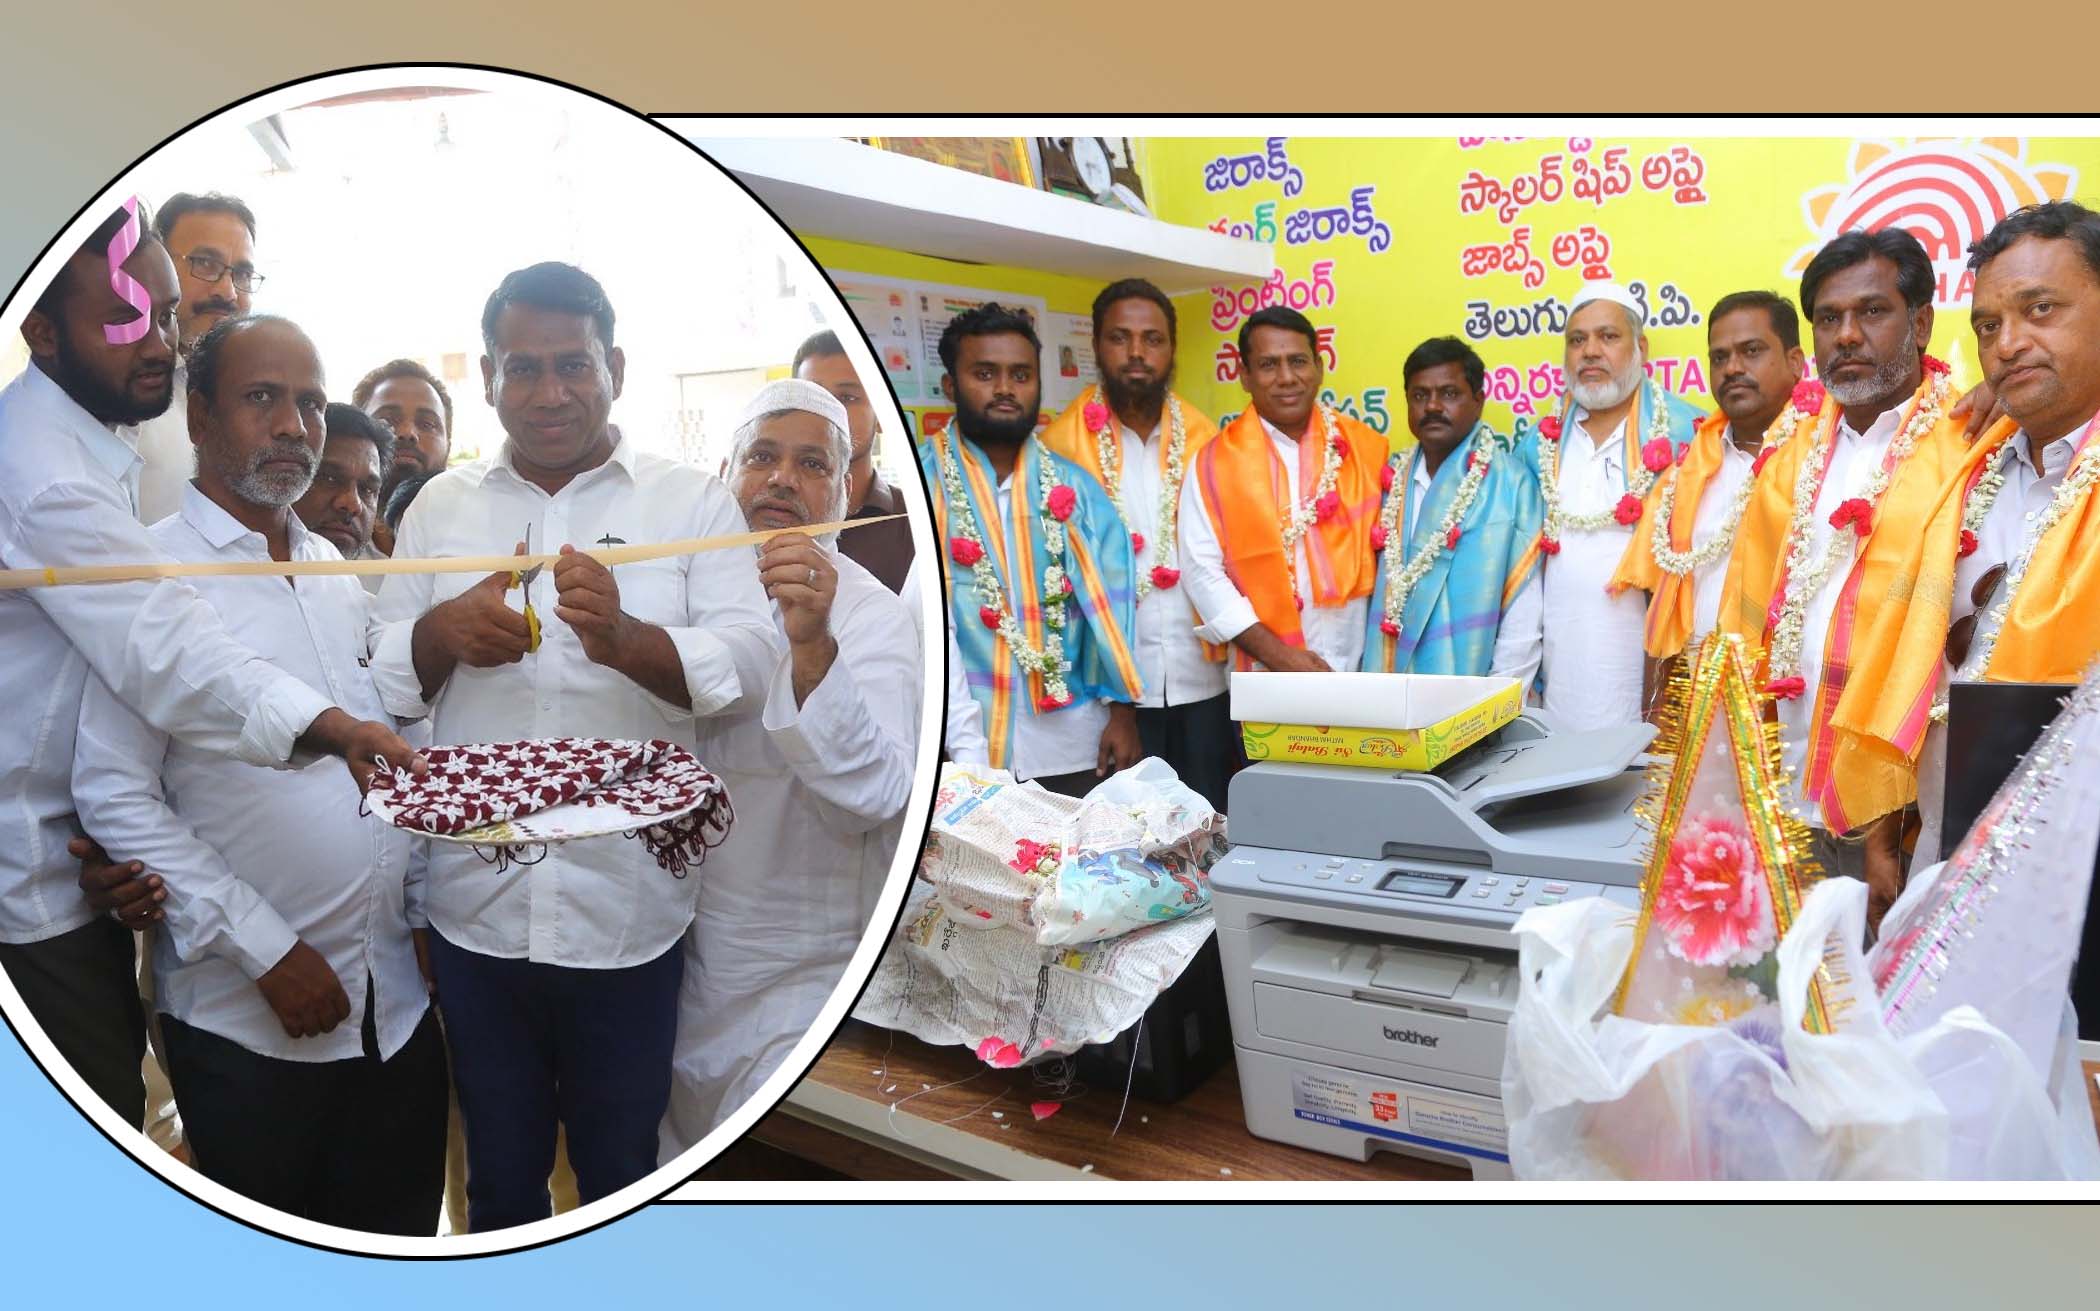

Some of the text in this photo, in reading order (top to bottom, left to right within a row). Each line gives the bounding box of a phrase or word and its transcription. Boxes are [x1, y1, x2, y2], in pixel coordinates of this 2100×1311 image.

[1205, 137, 1303, 197] జిరాక్స్
[1460, 155, 1563, 223] స్కాలర్
[1572, 148, 1632, 205] షిప్
[1284, 186, 1391, 252] జిరాక్స్
[1462, 228, 1545, 287] జాబ్స్
[1383, 1025, 1440, 1048] brother
